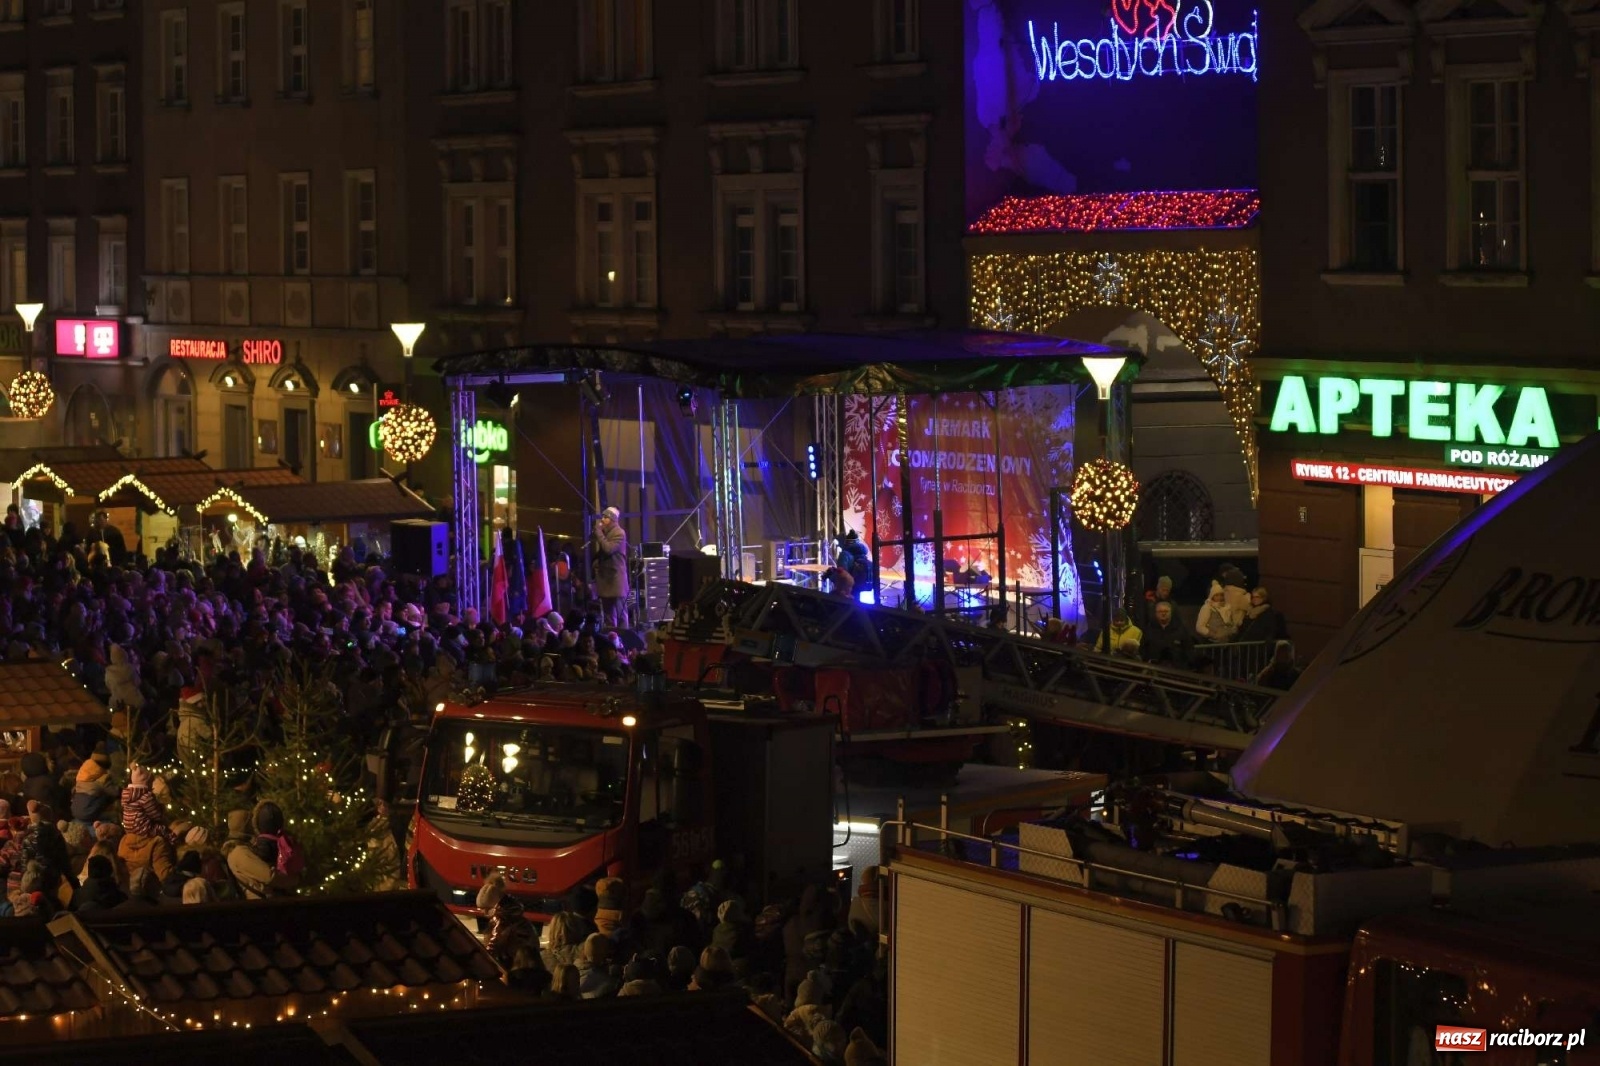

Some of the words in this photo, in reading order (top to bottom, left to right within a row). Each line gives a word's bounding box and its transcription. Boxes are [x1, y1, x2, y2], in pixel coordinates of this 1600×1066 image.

[170, 339, 226, 359] RESTAURACJA
[243, 340, 281, 364] SHIRO
[1270, 375, 1560, 448] APTEKA
[1450, 449, 1483, 464] POD
[1295, 463, 1334, 478] RYNEK
[1358, 468, 1414, 485] CENTRUM
